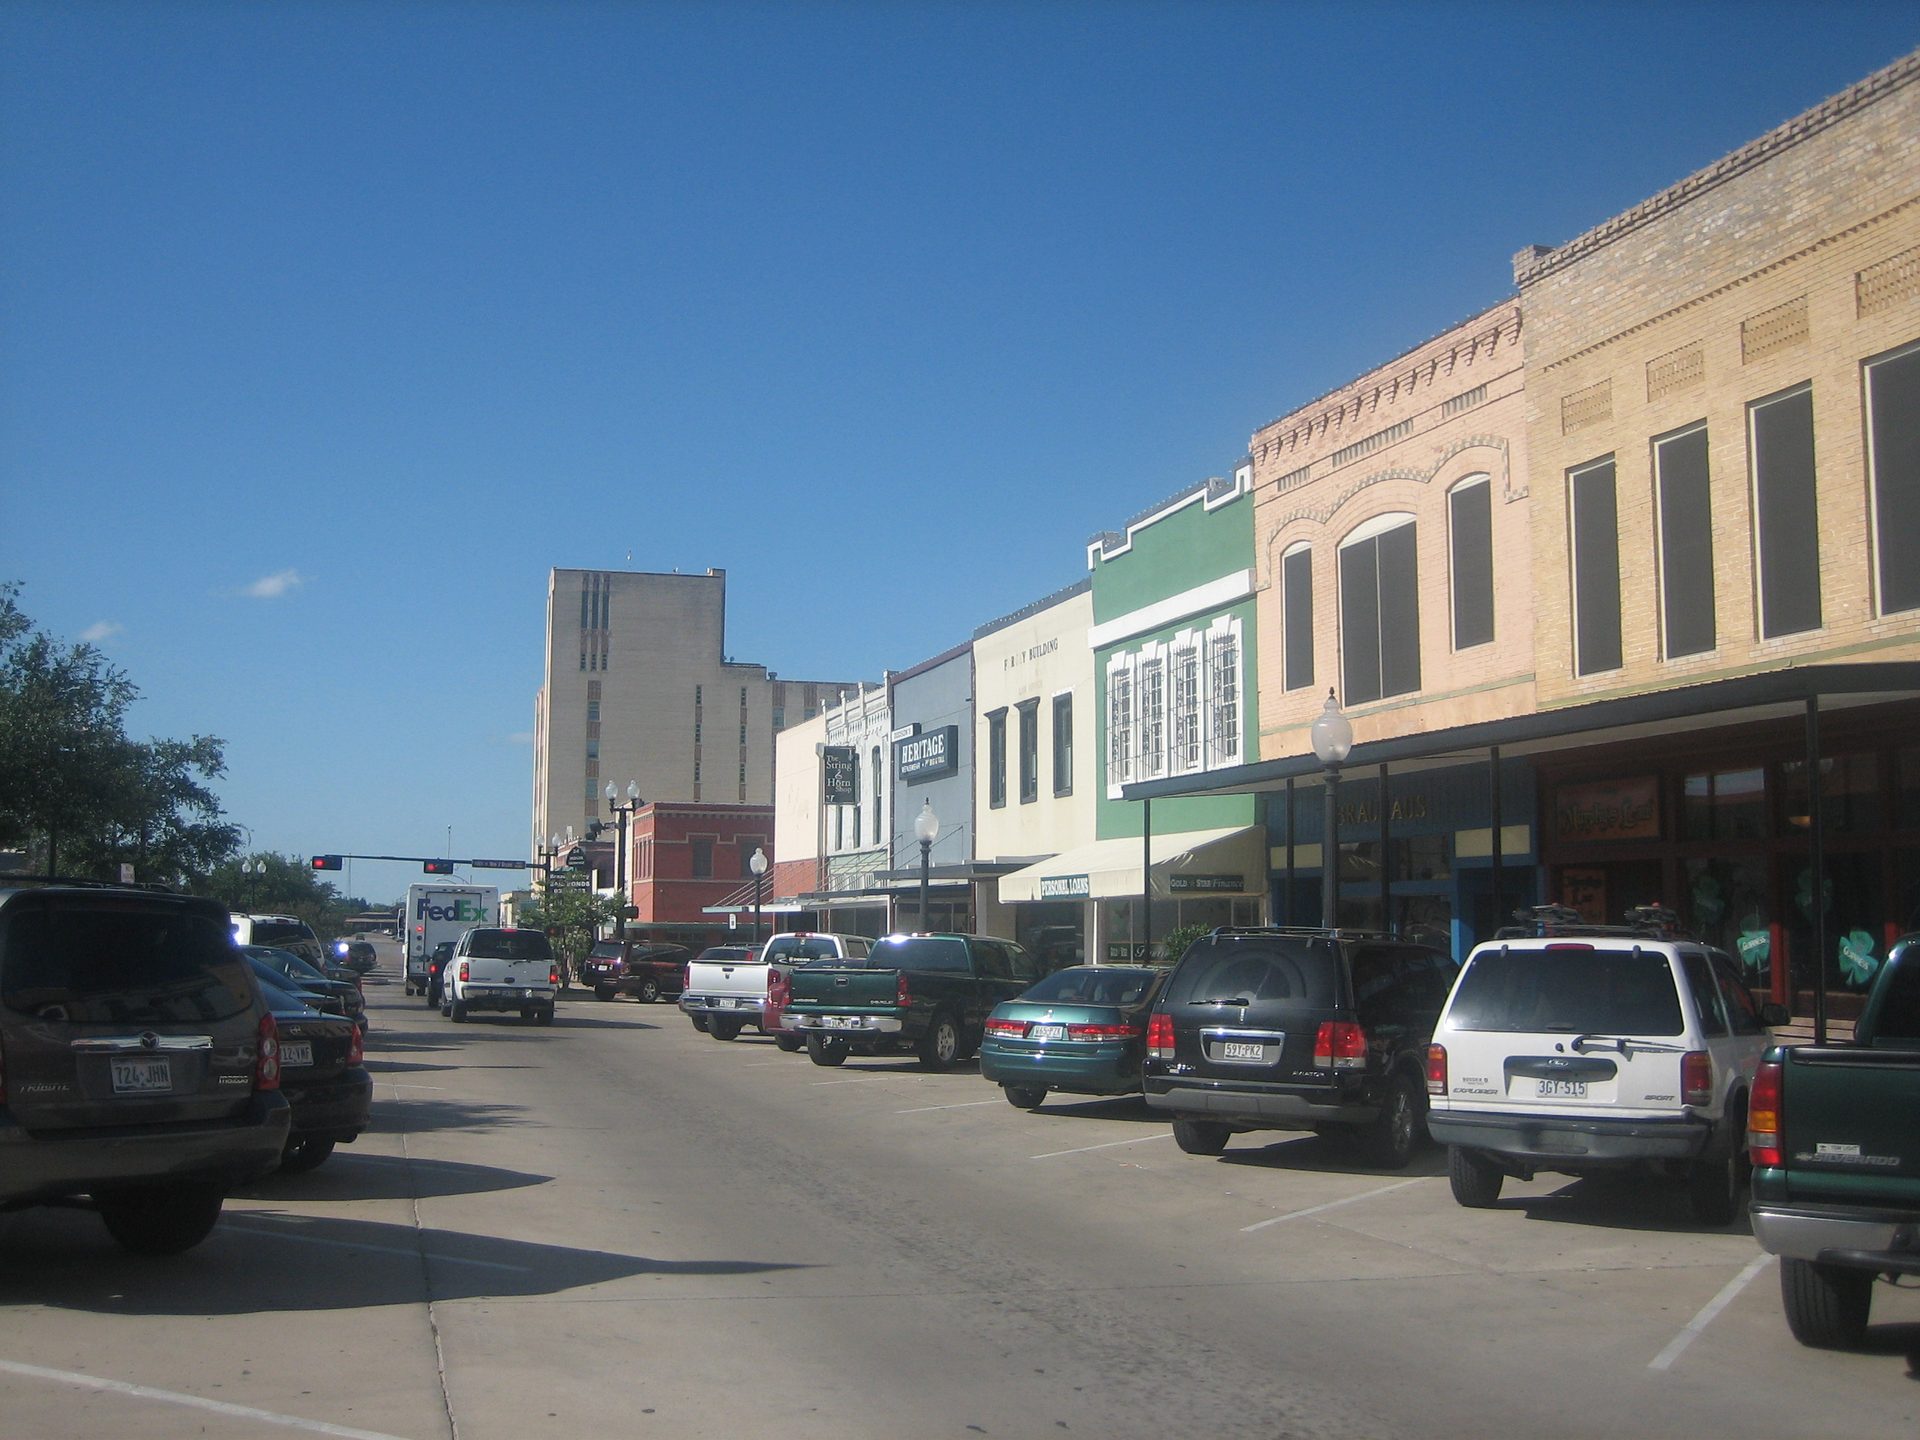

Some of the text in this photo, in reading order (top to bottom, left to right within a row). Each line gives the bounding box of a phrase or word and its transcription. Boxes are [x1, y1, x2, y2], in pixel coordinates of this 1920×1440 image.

[1029, 637, 1058, 661] BUILDING
[902, 734, 945, 764] HERITAGE
[826, 760, 852, 772] String
[827, 778, 851, 787] Horn
[835, 786, 852, 794] Shop
[1041, 877, 1089, 897] PERSONAL LOANS
[416, 898, 489, 922] FedEx
[1453, 1087, 1499, 1096] EXPLORER
[1538, 1080, 1585, 1096] 3GY-515
[1643, 1094, 1676, 1102] SPORT
[1811, 1153, 1901, 1167] SILVERADO
